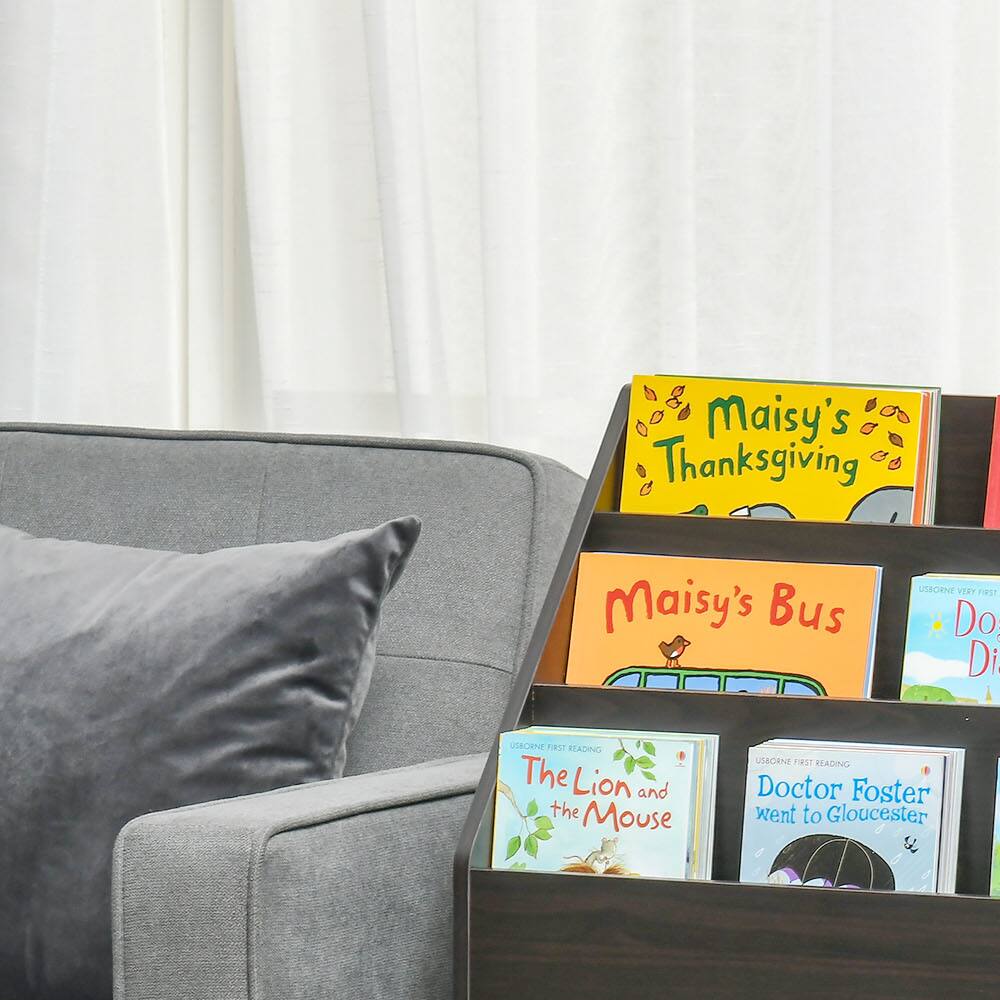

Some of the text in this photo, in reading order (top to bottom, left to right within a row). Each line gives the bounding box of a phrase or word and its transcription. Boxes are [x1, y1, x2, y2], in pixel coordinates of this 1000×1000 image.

[708, 394, 850, 444] Maisy's
[653, 435, 858, 487] Thanksgiving
[606, 579, 845, 634] Maisy's Bus
[918, 585, 955, 594] USBORNE
[957, 587, 976, 595] VERY
[978, 588, 997, 597] FIRST
[510, 742, 602, 753] USBORNE FIRST READING
[755, 757, 850, 768] USBORNE FIRST READING
[521, 754, 669, 799] The Lion and
[757, 774, 931, 804] Doctor Foster
[550, 800, 672, 832] the Mouse
[755, 803, 928, 825] went to Gloucester
